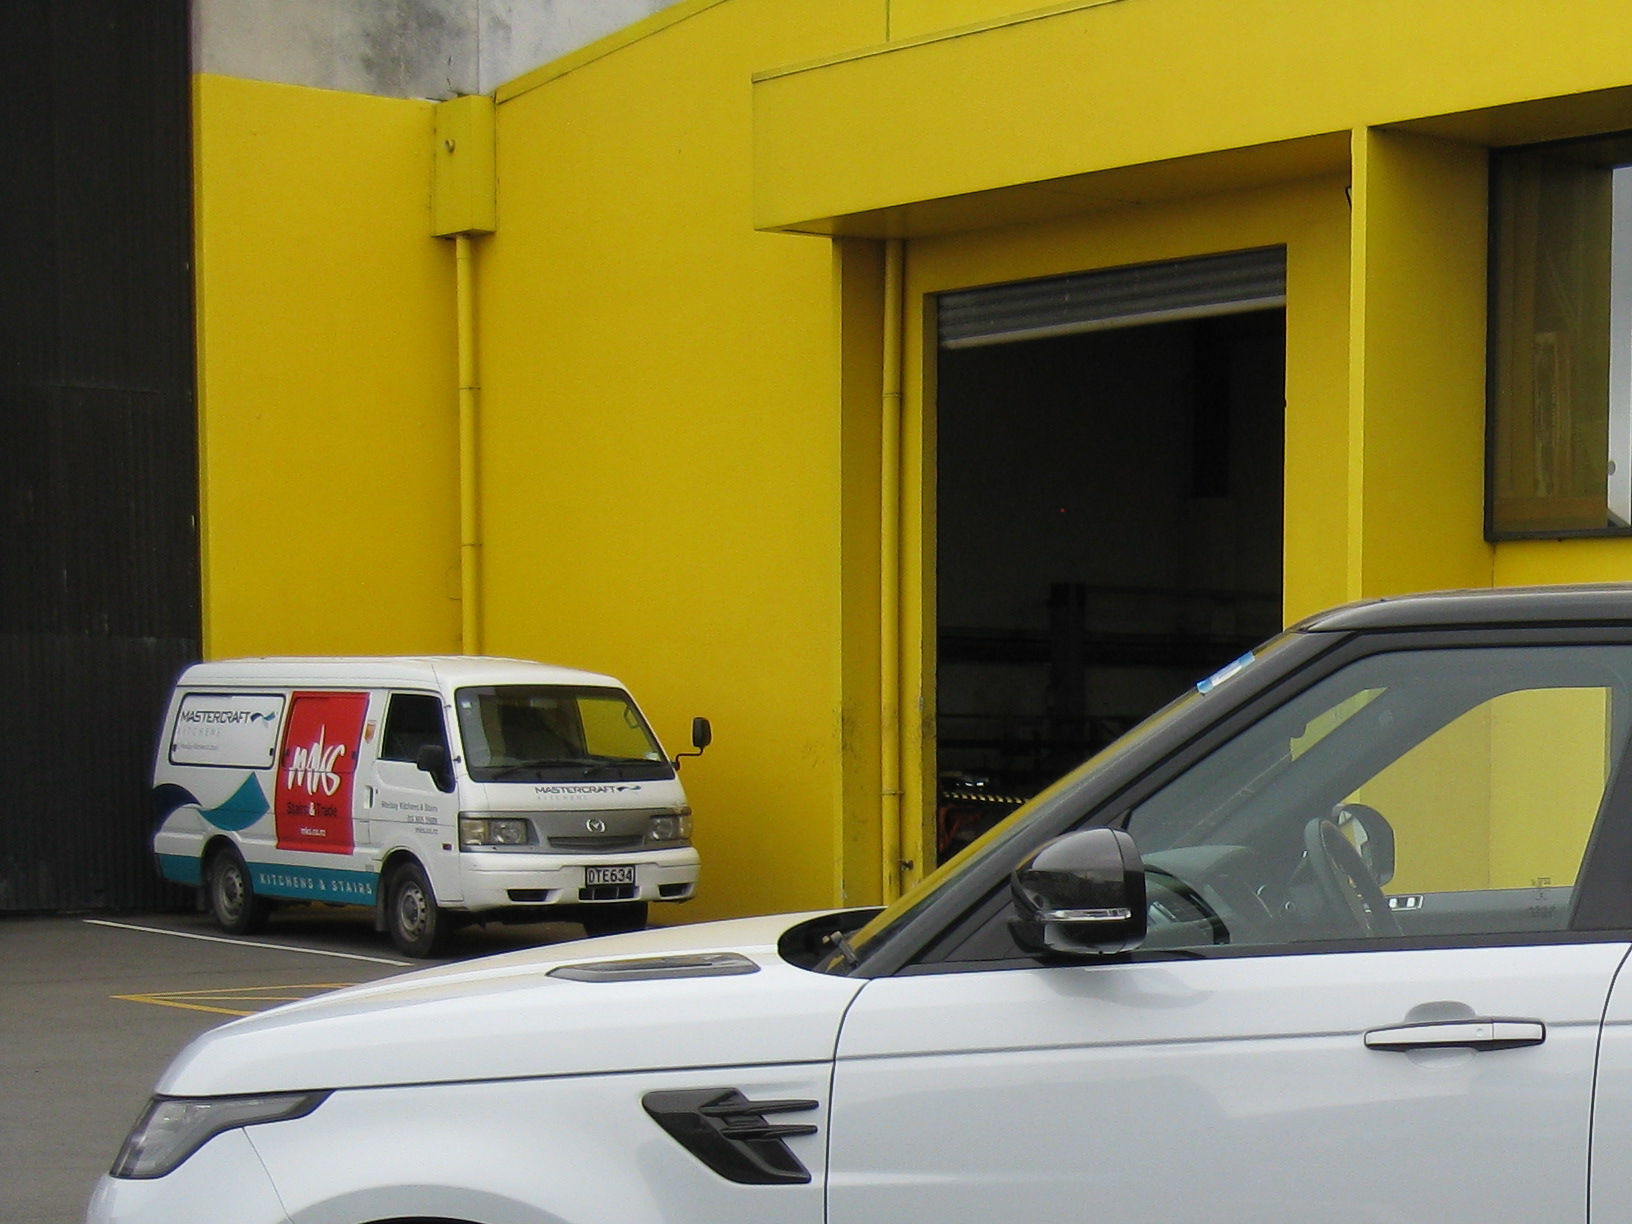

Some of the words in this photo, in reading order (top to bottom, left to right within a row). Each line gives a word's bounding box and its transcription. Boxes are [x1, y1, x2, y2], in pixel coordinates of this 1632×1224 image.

[180, 710, 251, 724] MASTERCRAFT
[178, 727, 221, 737] KITCHENS
[535, 785, 616, 794] MASTERCRAFT
[308, 801, 316, 816] &
[316, 803, 338, 817] Trade
[588, 867, 632, 884] DTE634
[259, 872, 314, 889] KITCHENS
[318, 879, 327, 891] &
[332, 880, 373, 895] STAIRS
